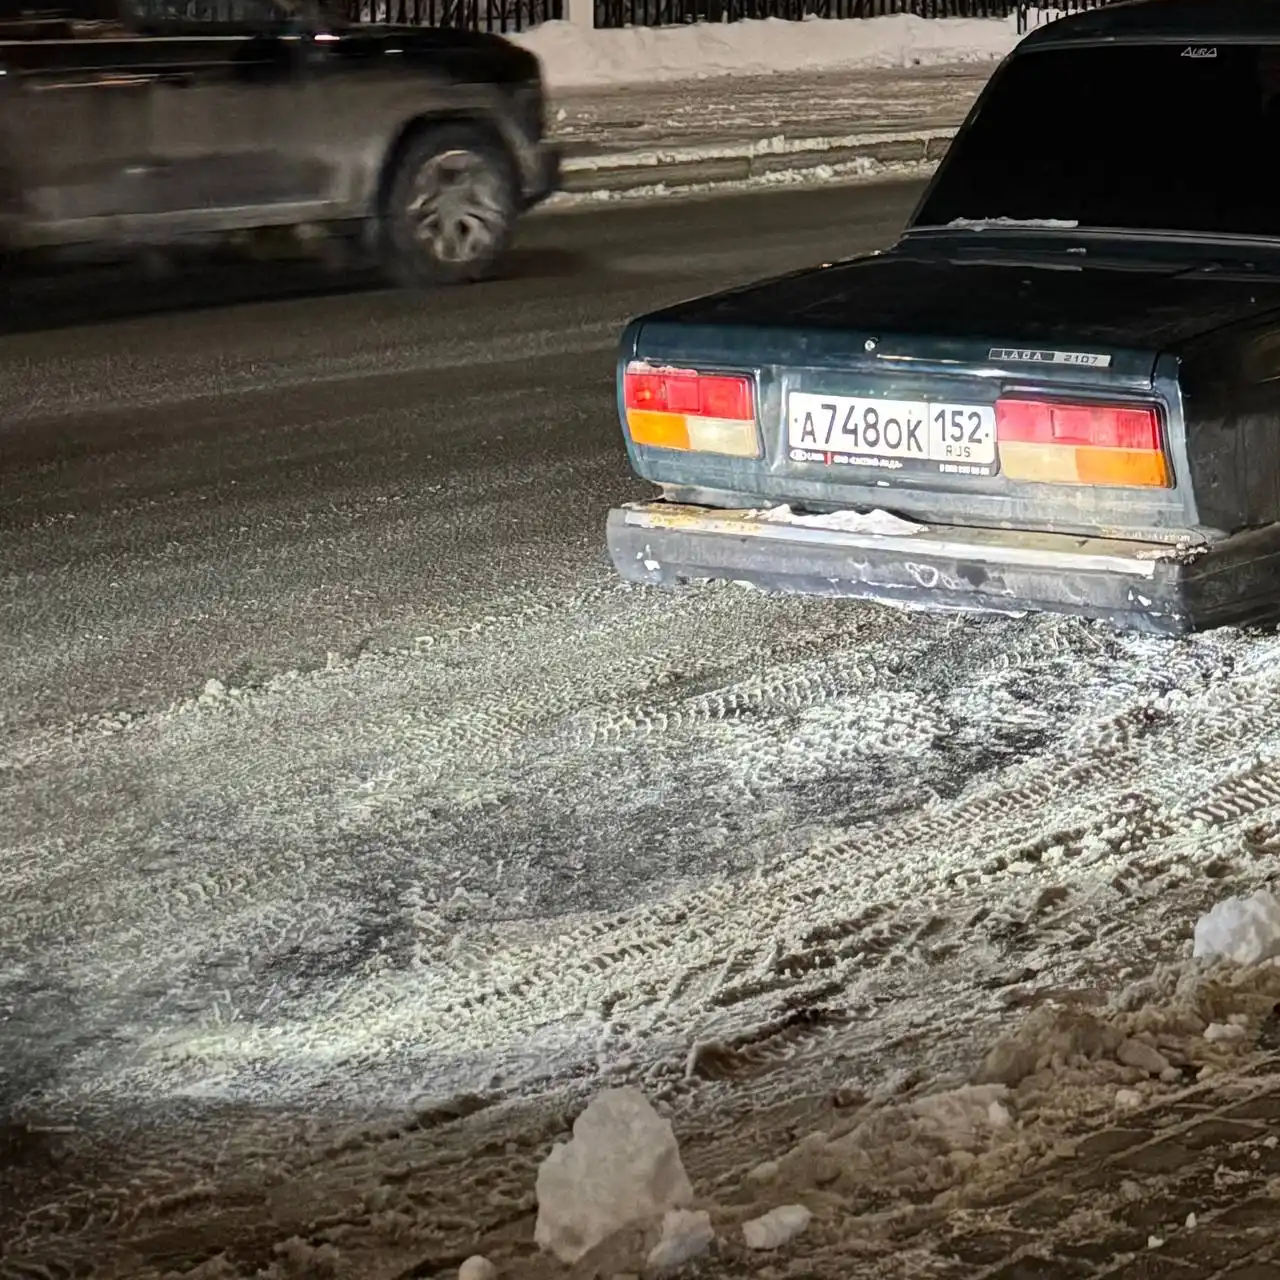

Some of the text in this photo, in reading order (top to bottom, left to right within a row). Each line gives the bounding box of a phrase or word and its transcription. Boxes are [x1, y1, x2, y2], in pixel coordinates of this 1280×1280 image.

[1063, 353, 1098, 365] 2107
[801, 403, 982, 452] А748ОК 152
[945, 445, 971, 458] RUS
